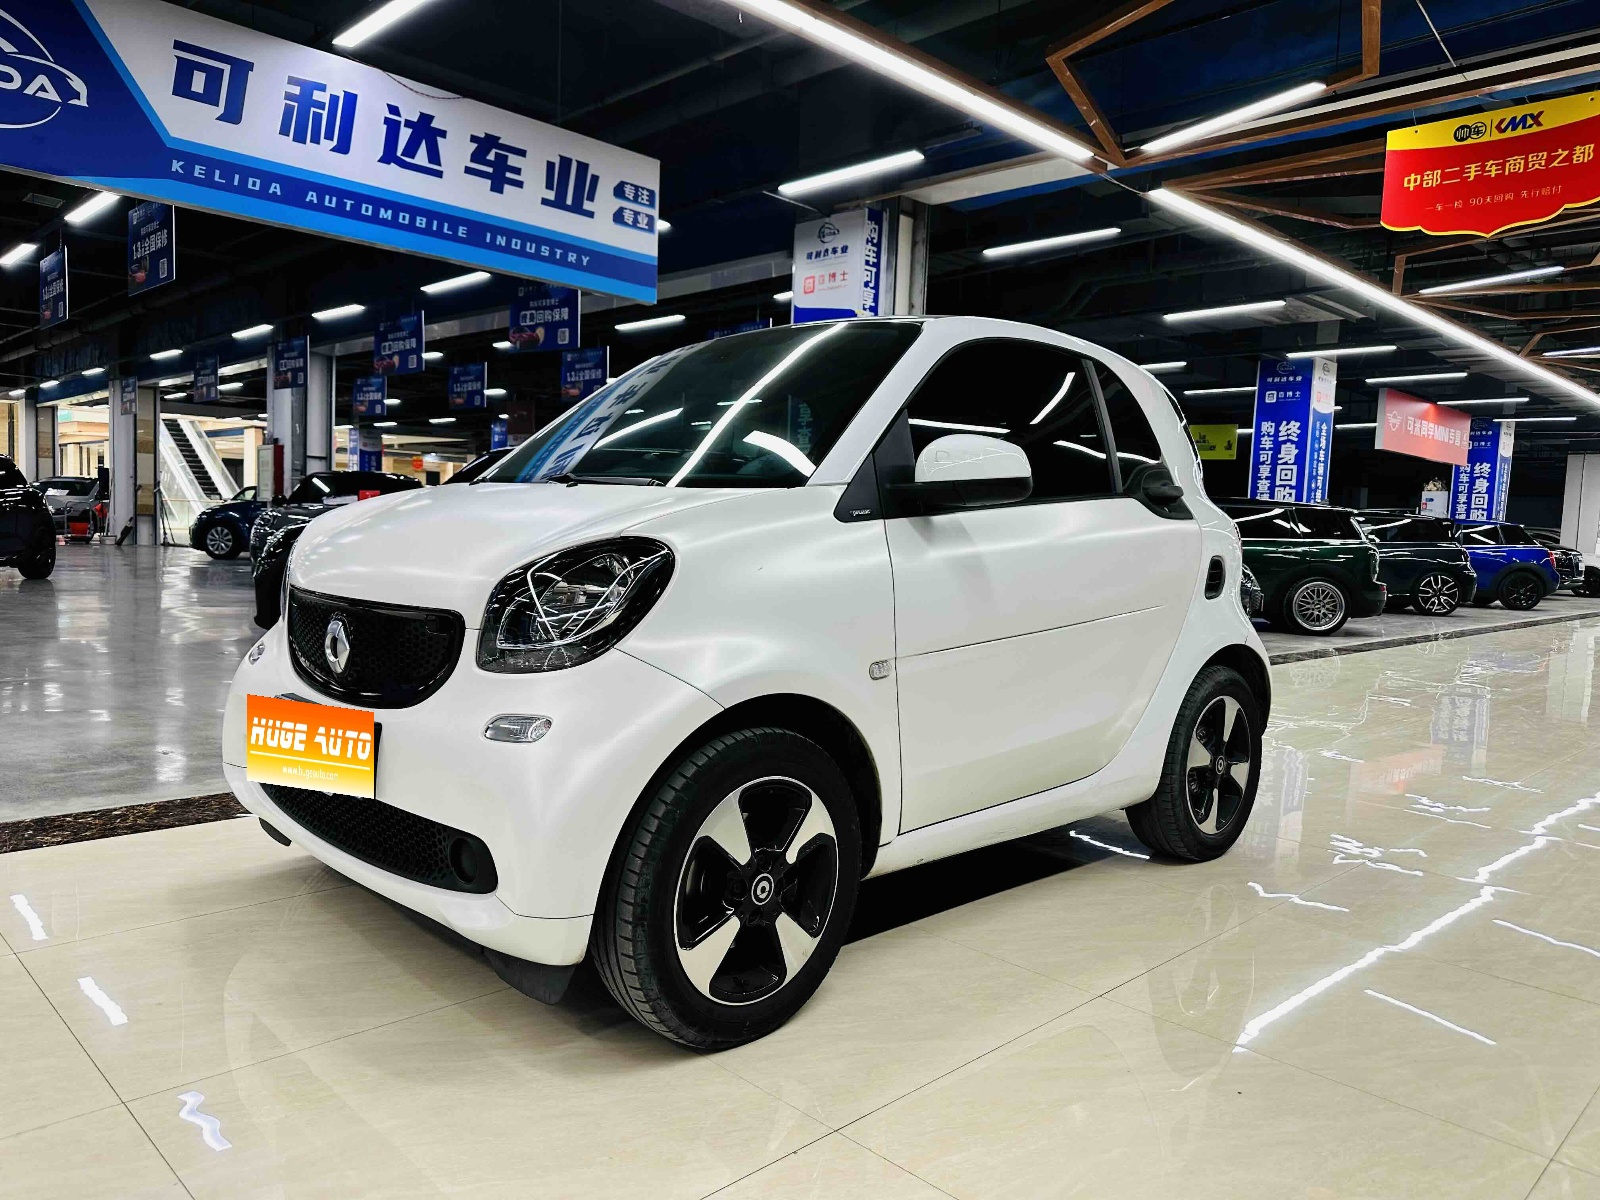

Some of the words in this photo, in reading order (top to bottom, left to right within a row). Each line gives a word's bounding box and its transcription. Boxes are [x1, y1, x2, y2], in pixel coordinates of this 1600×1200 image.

[171, 38, 599, 219] 可利达车业
[1453, 120, 1487, 142] 帅车
[1403, 143, 1595, 191] 中部二手车商贸之都
[623, 183, 650, 205] 专注
[1425, 199, 1463, 212] 一车一检
[1469, 192, 1514, 207] 90天回购
[1520, 185, 1563, 199] 先行赔付
[170, 158, 283, 197] KELIDA
[305, 190, 469, 239] AUTOMOBILE
[485, 231, 591, 267] INDUSTRY
[622, 208, 649, 230] 专业
